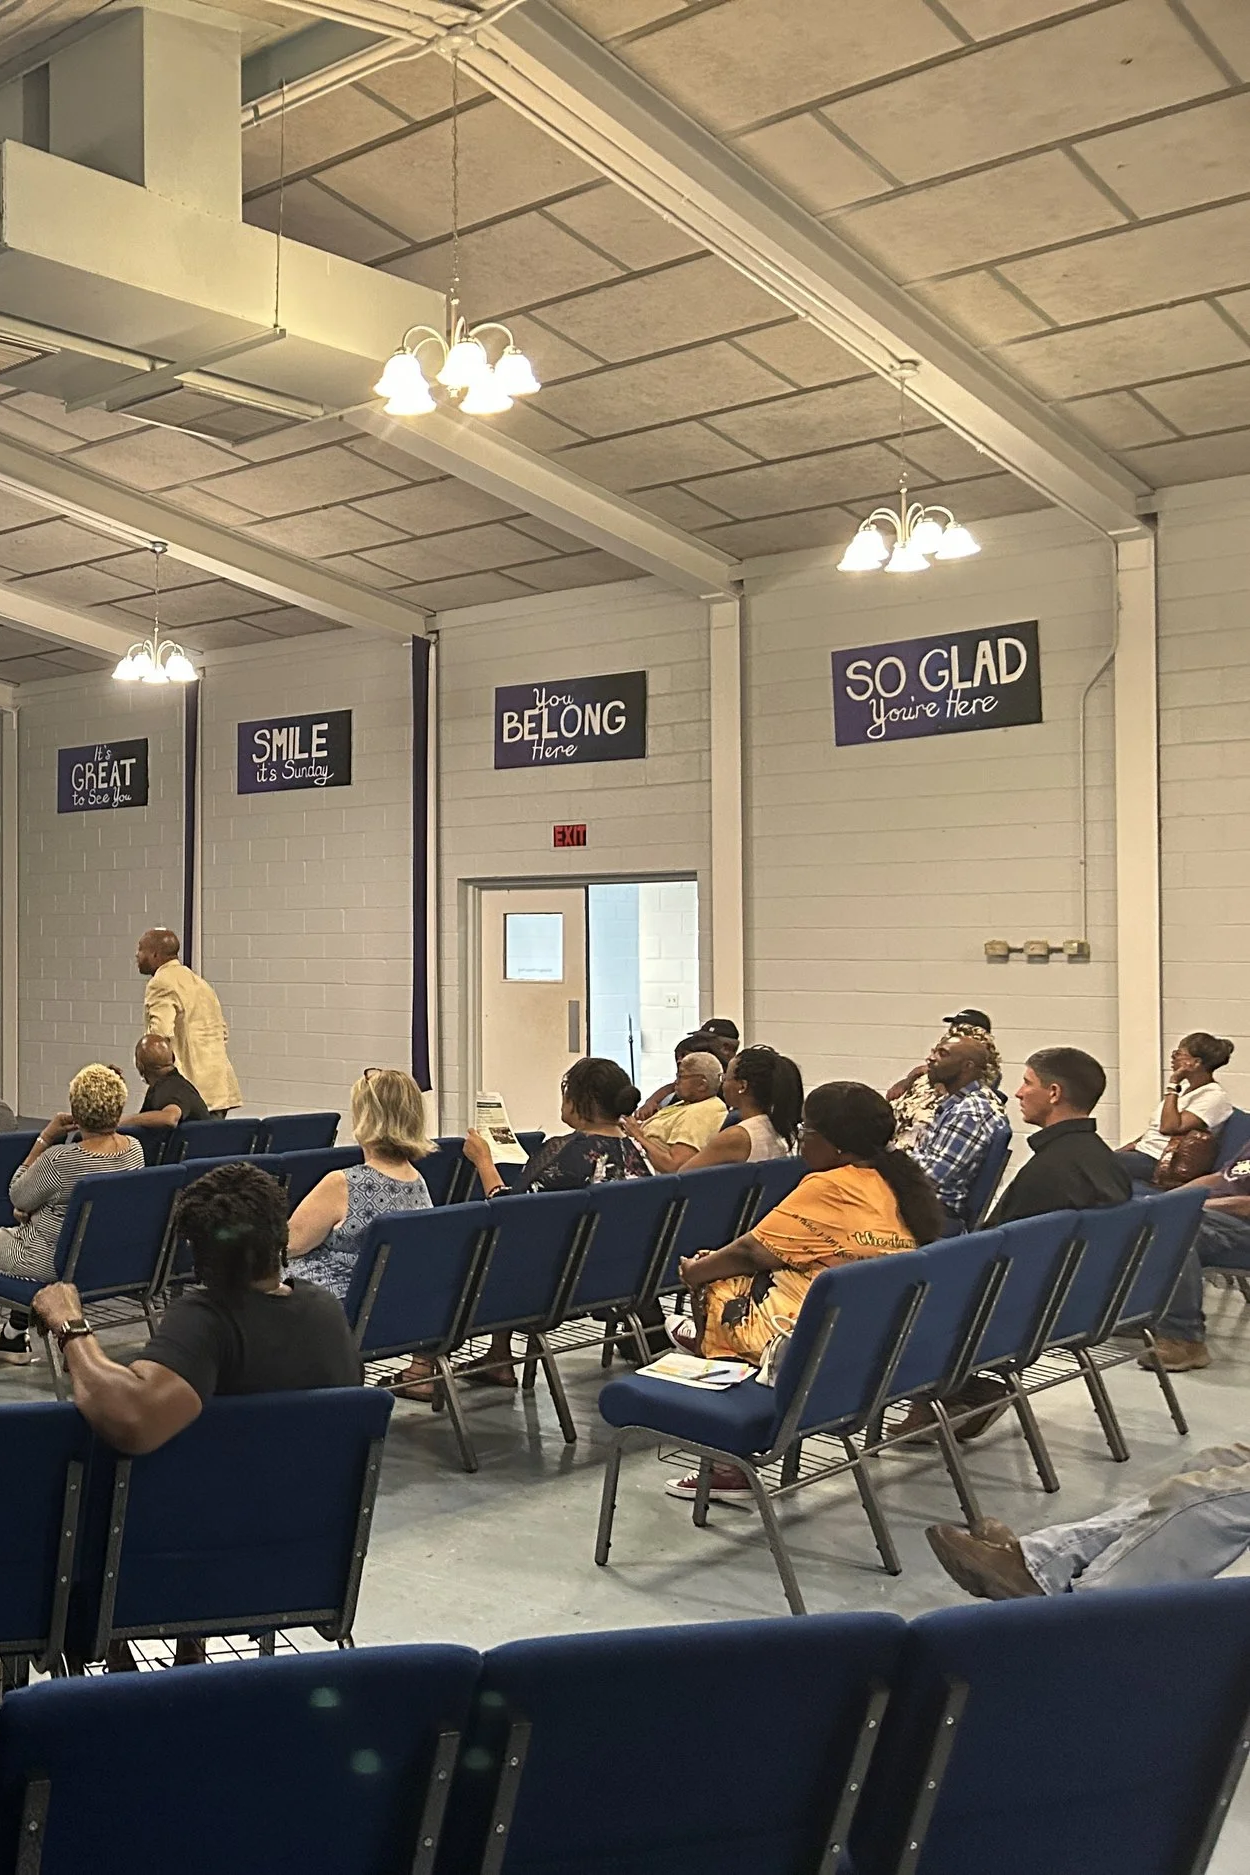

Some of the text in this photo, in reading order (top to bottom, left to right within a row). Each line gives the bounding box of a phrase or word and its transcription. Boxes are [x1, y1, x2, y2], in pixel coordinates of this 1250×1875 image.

[846, 637, 1027, 701] SO GLAD
[533, 688, 574, 715] You
[867, 689, 998, 739] You're Here
[503, 700, 626, 743] BELONG
[94, 745, 111, 761] It's
[252, 723, 328, 763] SMILE
[532, 737, 577, 760] Here
[71, 758, 136, 791] GREAT
[256, 758, 334, 786] it's Sunday
[72, 786, 132, 808] to See You
[554, 825, 585, 846] EXIT
